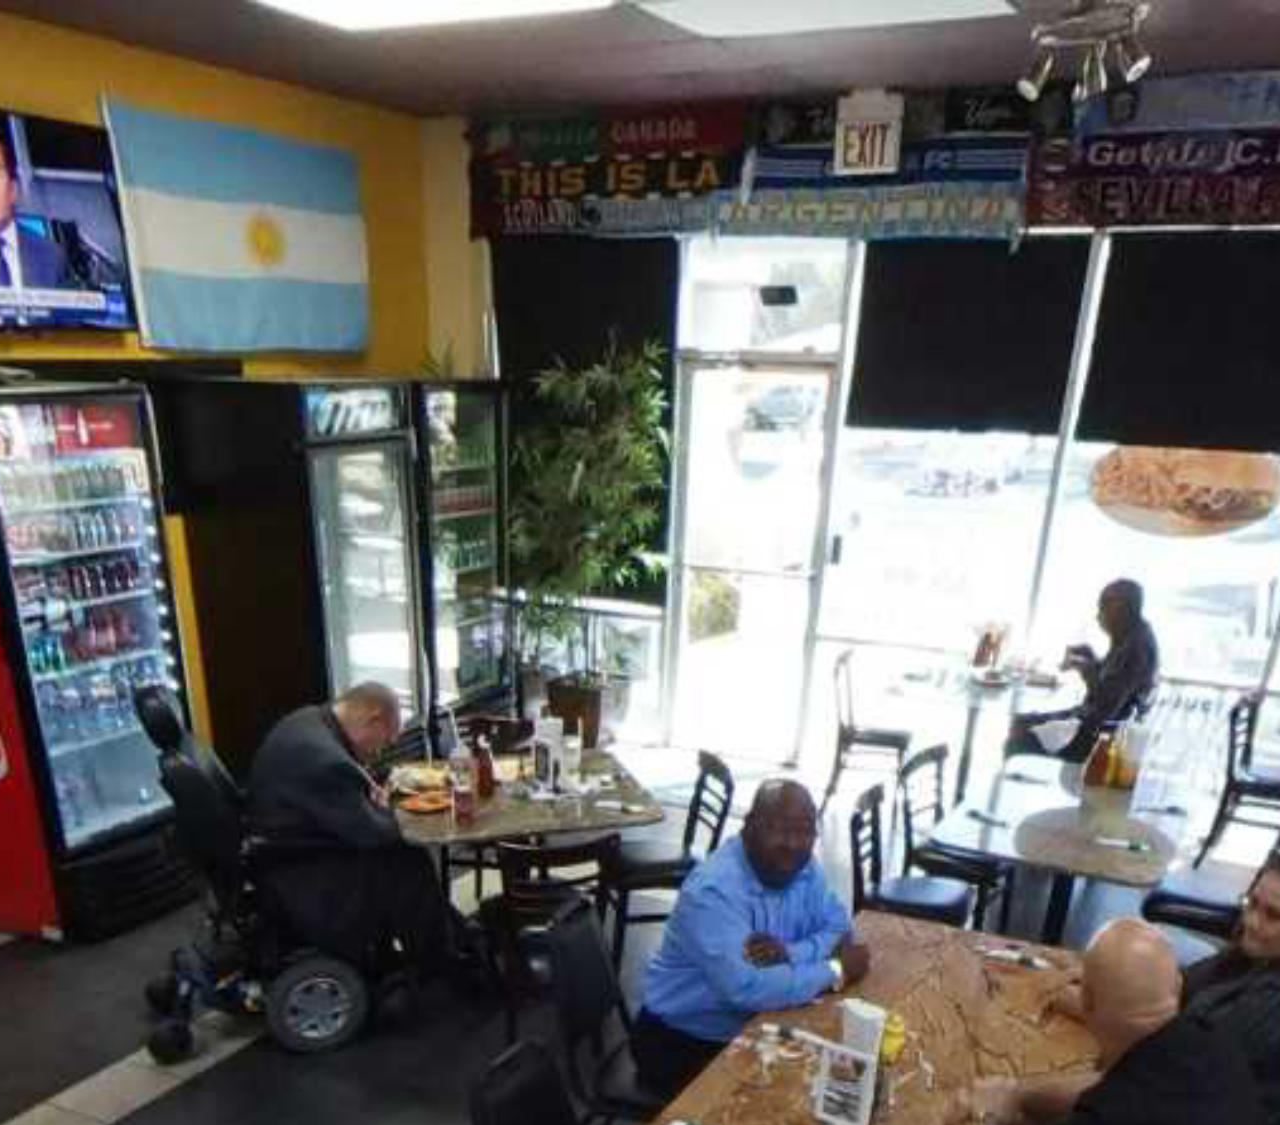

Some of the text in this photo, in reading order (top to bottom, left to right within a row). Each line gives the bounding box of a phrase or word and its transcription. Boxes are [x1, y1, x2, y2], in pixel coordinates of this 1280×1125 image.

[843, 124, 887, 170] EXIT
[495, 159, 719, 198] THIS IS LA
